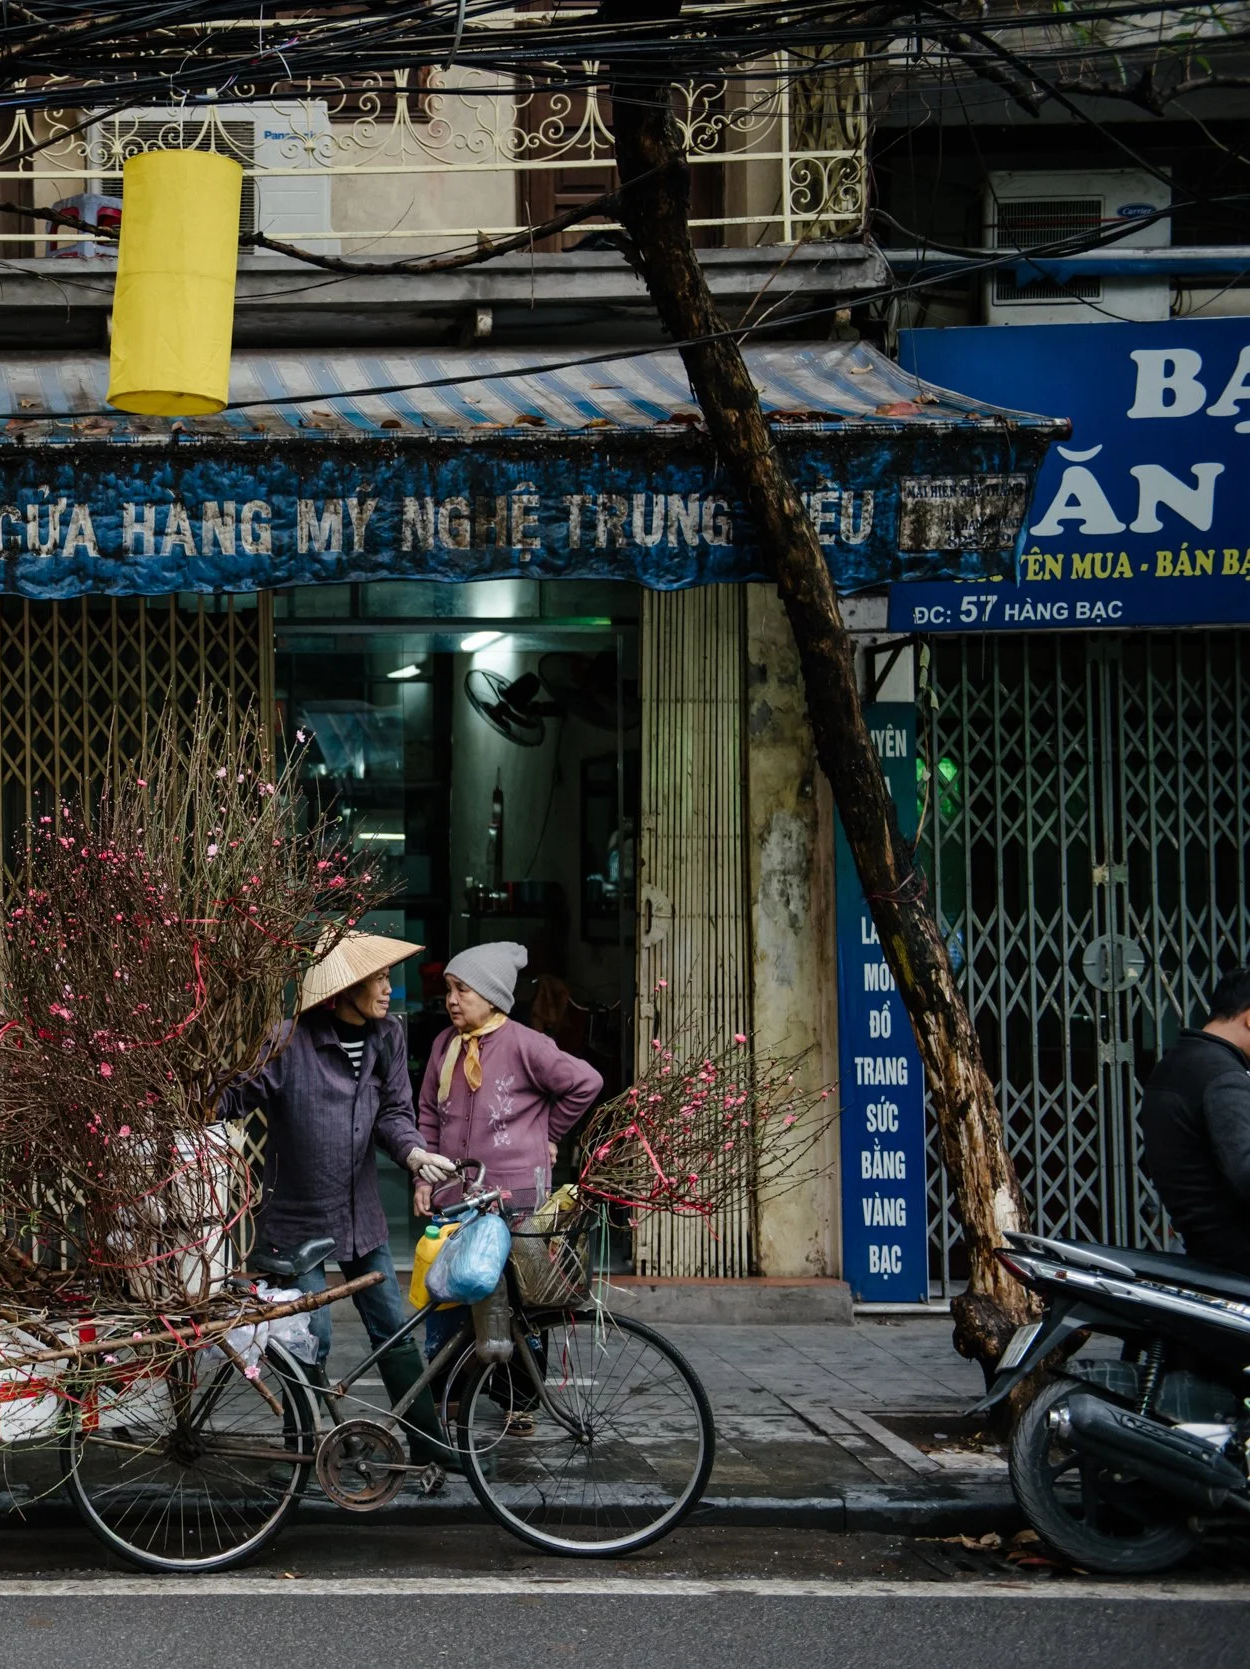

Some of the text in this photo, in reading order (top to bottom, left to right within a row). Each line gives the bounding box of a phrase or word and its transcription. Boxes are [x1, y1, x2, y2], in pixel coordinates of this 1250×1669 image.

[1122, 207, 1152, 215] Carrier
[122, 488, 272, 556] HÀNG
[401, 481, 542, 562] NGHỆ
[562, 492, 734, 548] TRUNG
[1070, 551, 1133, 580] MUA
[1155, 542, 1216, 577] BÁN
[913, 595, 1123, 624] ĐC: 57 HÀNG BẠC
[869, 1000, 892, 1039] ĐỒ
[855, 1057, 908, 1086] TRANG
[866, 1096, 898, 1133] SỨC
[861, 1137, 906, 1180] BẰNG
[862, 1191, 906, 1227] VÀNG
[869, 1245, 902, 1281] BẠC
